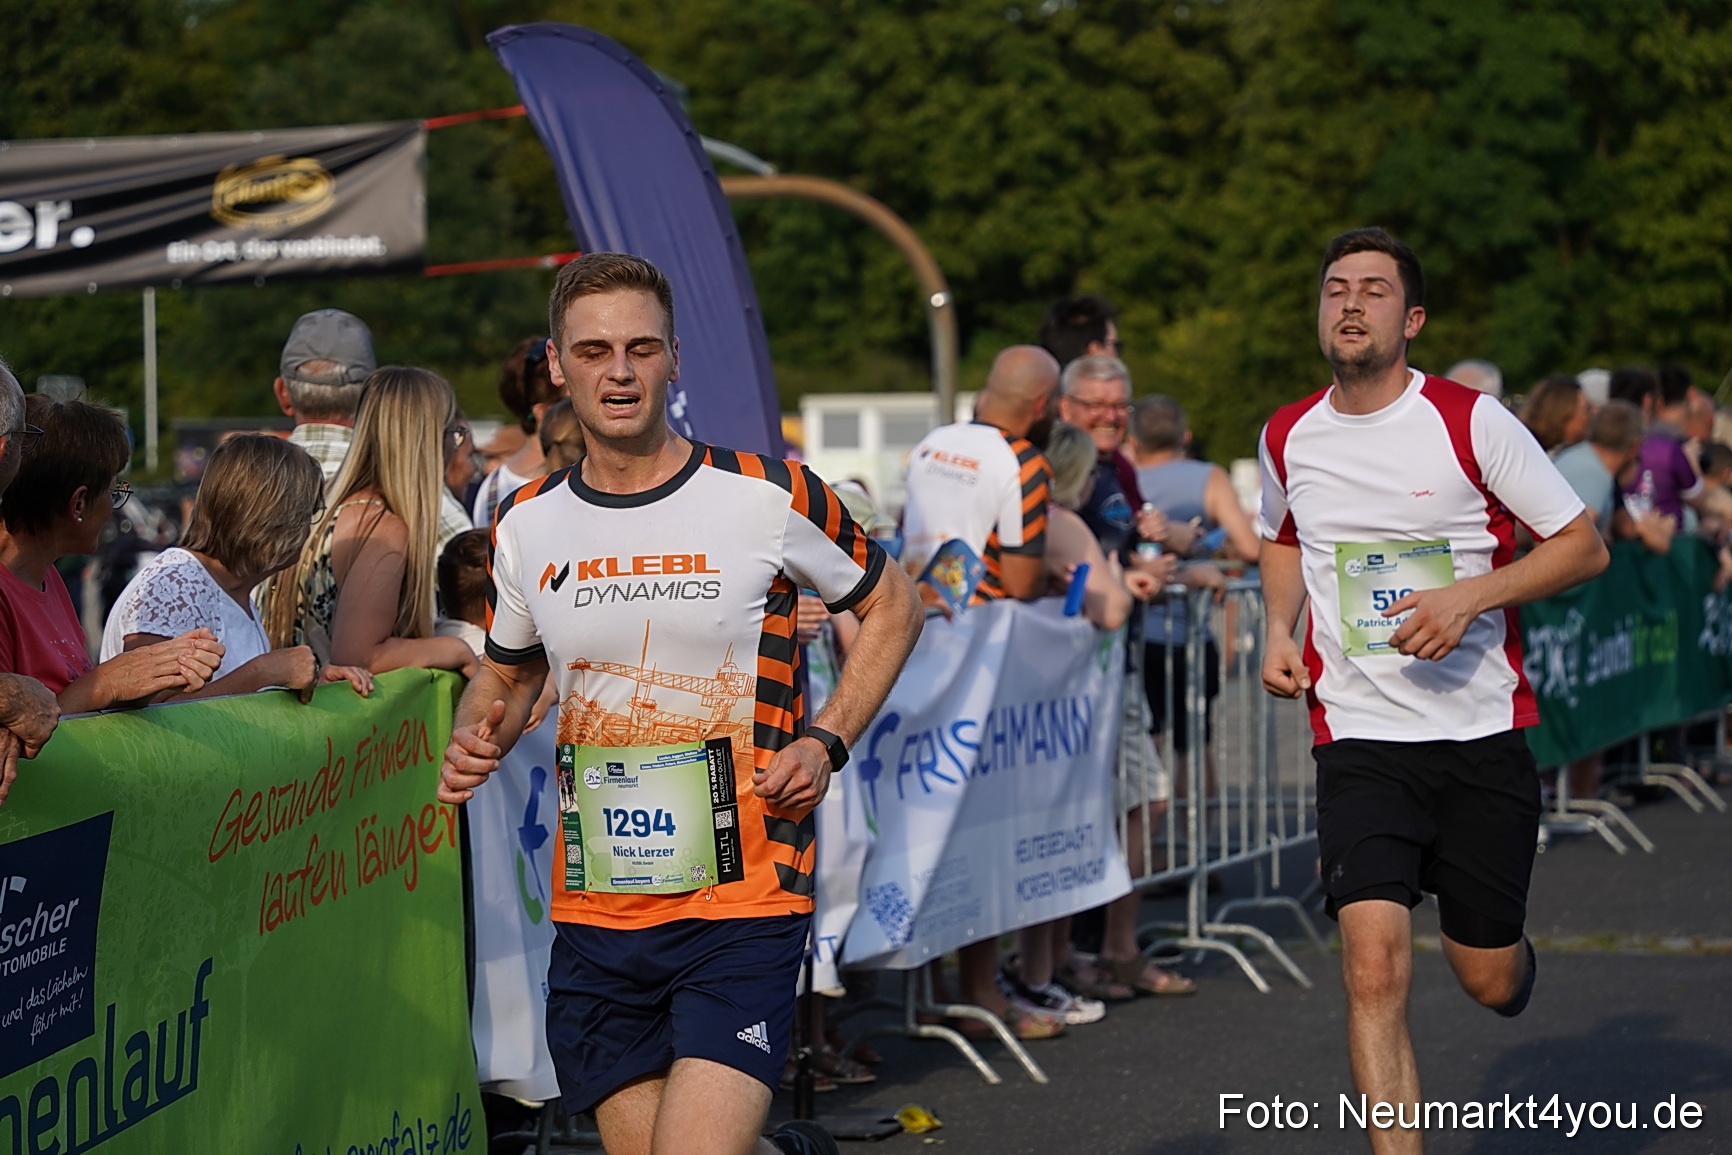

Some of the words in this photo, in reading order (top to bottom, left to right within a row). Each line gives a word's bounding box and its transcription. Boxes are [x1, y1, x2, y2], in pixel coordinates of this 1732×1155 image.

[577, 554, 720, 581] KLEBL
[574, 580, 721, 608] DYNAMICS
[1357, 616, 1392, 628] Patrick
[561, 755, 573, 763] AOK
[716, 748, 724, 774] OUTLET
[897, 694, 1092, 801] FRISCHMANN
[603, 776, 638, 784] Firmenlauf
[707, 749, 718, 783] RABATT
[208, 737, 345, 863] Gesunde
[350, 718, 434, 799] Firmen
[712, 782, 719, 791] %
[712, 791, 720, 804] 20
[718, 773, 727, 803] FACTORY
[603, 808, 676, 837] 1294
[613, 845, 635, 859] Nick
[638, 845, 675, 858] Lerzer
[720, 831, 731, 873] HILTL
[258, 834, 347, 936] laufen
[356, 802, 457, 892] länger
[2, 997, 24, 1028] und
[26, 987, 46, 1011] das
[30, 1008, 58, 1047] fährt
[59, 987, 84, 1017] mit!
[736, 1031, 771, 1055] adidas
